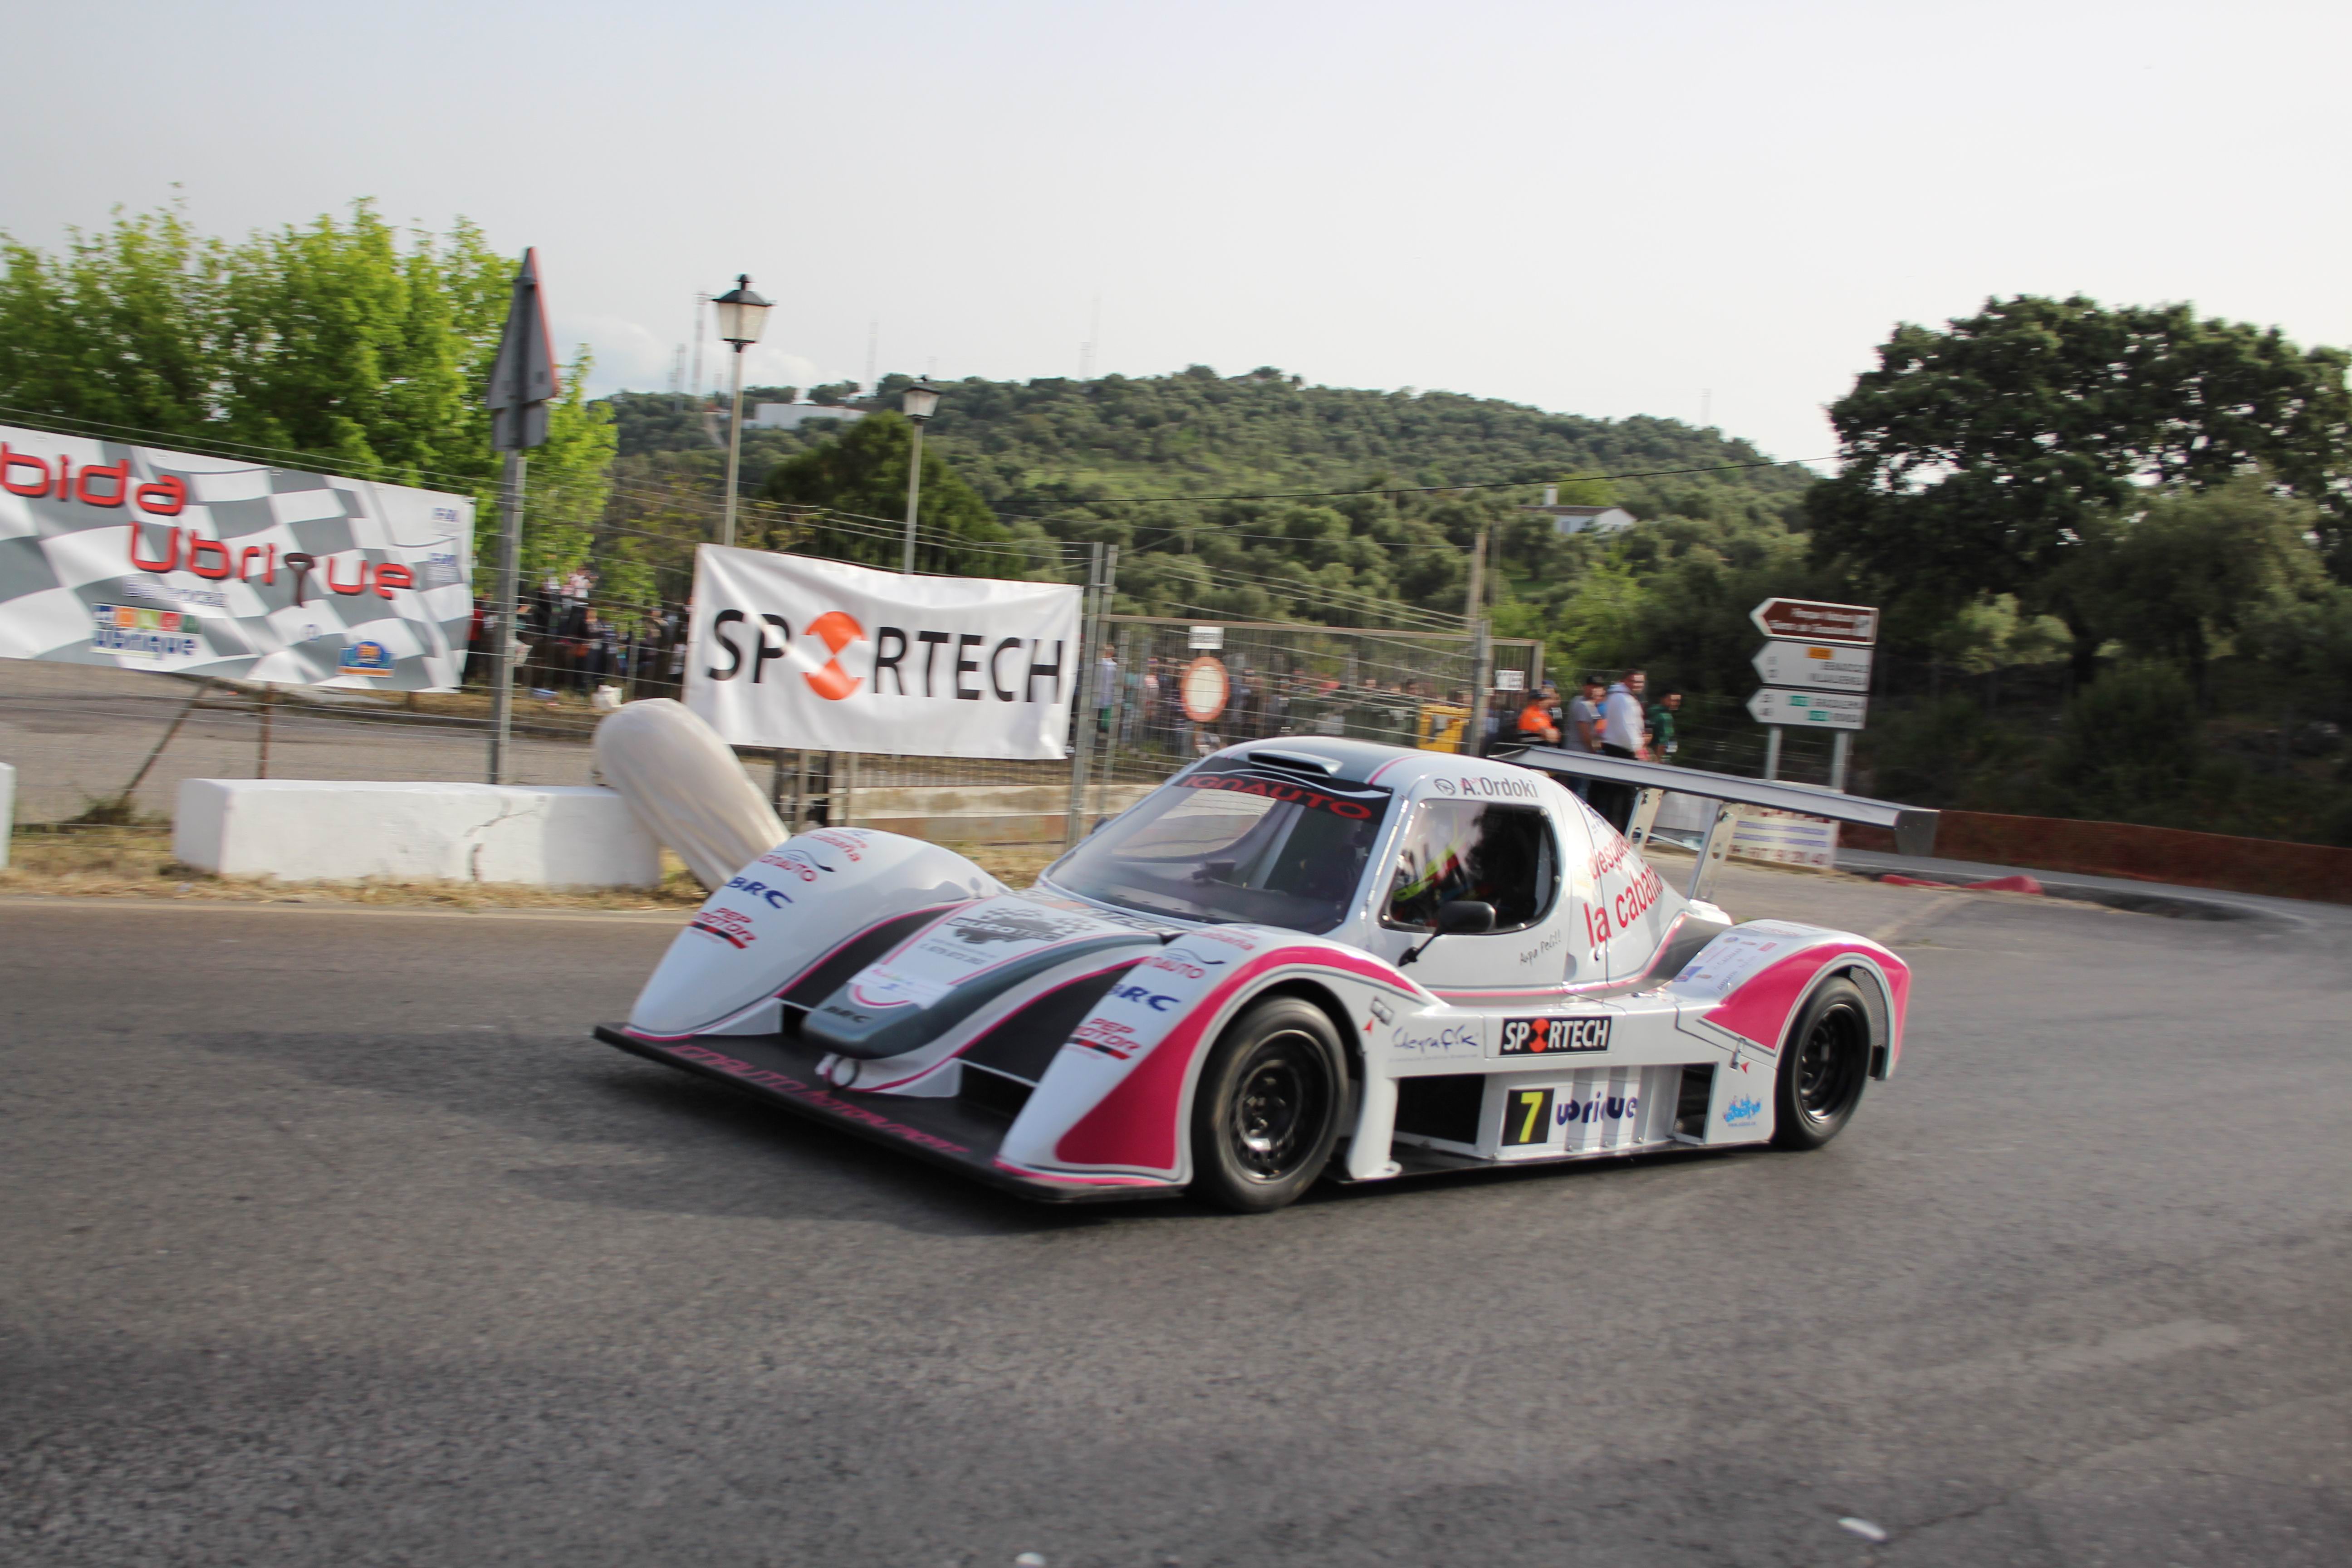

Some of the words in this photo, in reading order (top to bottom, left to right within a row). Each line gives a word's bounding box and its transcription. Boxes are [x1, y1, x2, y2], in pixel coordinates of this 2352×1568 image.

[706, 608, 1064, 704] SPORTECH
[726, 876, 794, 909] BRC
[1583, 901, 1612, 947] la
[1502, 1017, 1610, 1054] SPORTECH
[1518, 1091, 1544, 1143] 7
